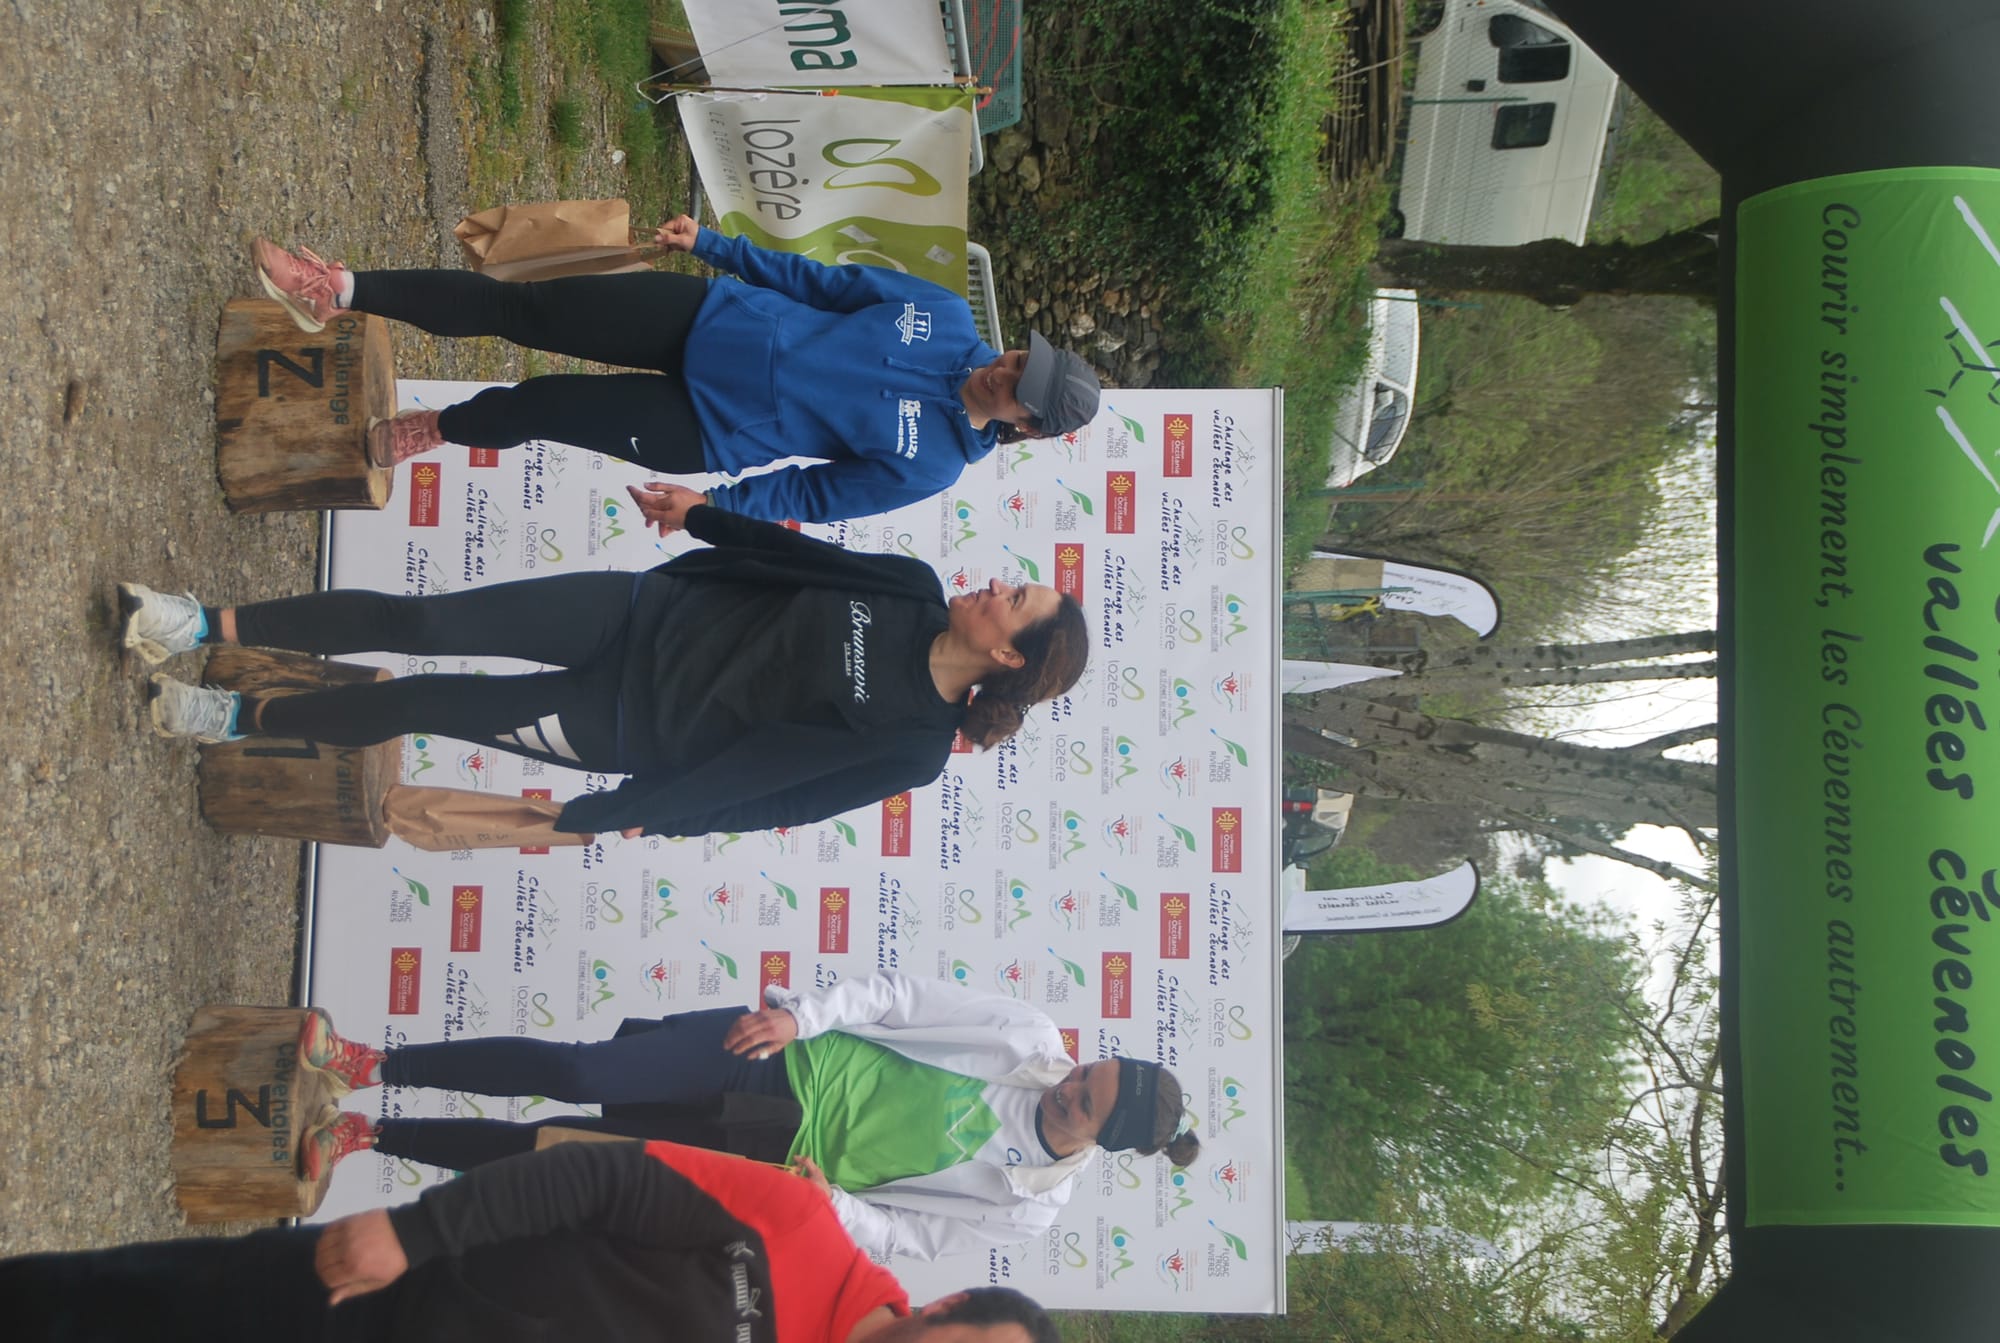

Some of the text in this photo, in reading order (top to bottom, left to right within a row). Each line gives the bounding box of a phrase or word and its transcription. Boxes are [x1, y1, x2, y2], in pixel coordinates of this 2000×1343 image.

[776, 0, 858, 71] ma
[740, 120, 809, 220] lozère
[1821, 203, 1861, 335] Courir
[330, 318, 357, 425] Challenge
[523, 459, 533, 510] cévenoles
[532, 443, 546, 504] llenge des
[1212, 409, 1223, 508] vallées cévenoles
[1221, 416, 1234, 502] Challenge des
[1808, 350, 1863, 608] simplement,
[420, 489, 428, 523] Occitanie
[464, 482, 476, 582] vallées cévenoles
[474, 489, 487, 576] Challenge des
[406, 541, 416, 582] vallées
[418, 548, 428, 595] Challen
[525, 522, 538, 568] lozère
[1160, 491, 1172, 591] vallées cévenoles
[1170, 498, 1182, 585] Challenge des
[1217, 520, 1229, 566] lozère
[1104, 549, 1115, 648] vallées cévenoles
[1112, 555, 1125, 642] Challenge des
[1166, 603, 1178, 650] lozère
[1107, 660, 1119, 707] lozère
[1821, 629, 1863, 685] les
[1063, 696, 1071, 716] des
[1009, 765, 1018, 784] des
[1056, 734, 1068, 782] lozère
[941, 769, 951, 870] vallées cévenoles
[950, 776, 962, 864] Challenge des
[1001, 802, 1013, 850] lozère
[1822, 703, 1864, 901] Cévennes
[595, 844, 604, 863] des
[1922, 543, 1992, 1176] vallées cévenoles
[462, 913, 470, 948] Occitanie
[514, 870, 525, 973] vallées cévenoles
[525, 877, 538, 967] Challenge des
[585, 882, 598, 930] lozère
[878, 872, 889, 969] vallées cévenole
[888, 879, 900, 968] Challenge des
[944, 882, 956, 930] lozère
[1209, 883, 1219, 986] vallées cévenoles
[1218, 889, 1230, 979] Challenge des
[446, 962, 455, 1005] vallées
[456, 969, 468, 1031] Challenge
[815, 963, 823, 988] vall
[516, 986, 529, 1035] lozère
[1157, 969, 1167, 1064] vallées cévenol
[1166, 976, 1178, 1067] Challenge des
[1214, 998, 1226, 1047] lozère
[1099, 1028, 1110, 1060] vallé
[196, 1084, 271, 1129] 3
[272, 1042, 296, 1160] Cévenoles
[1103, 1150, 1115, 1196] ozère
[989, 1248, 998, 1284] enoles
[1001, 1257, 1010, 1277] des
[1049, 1224, 1061, 1275] lozère
